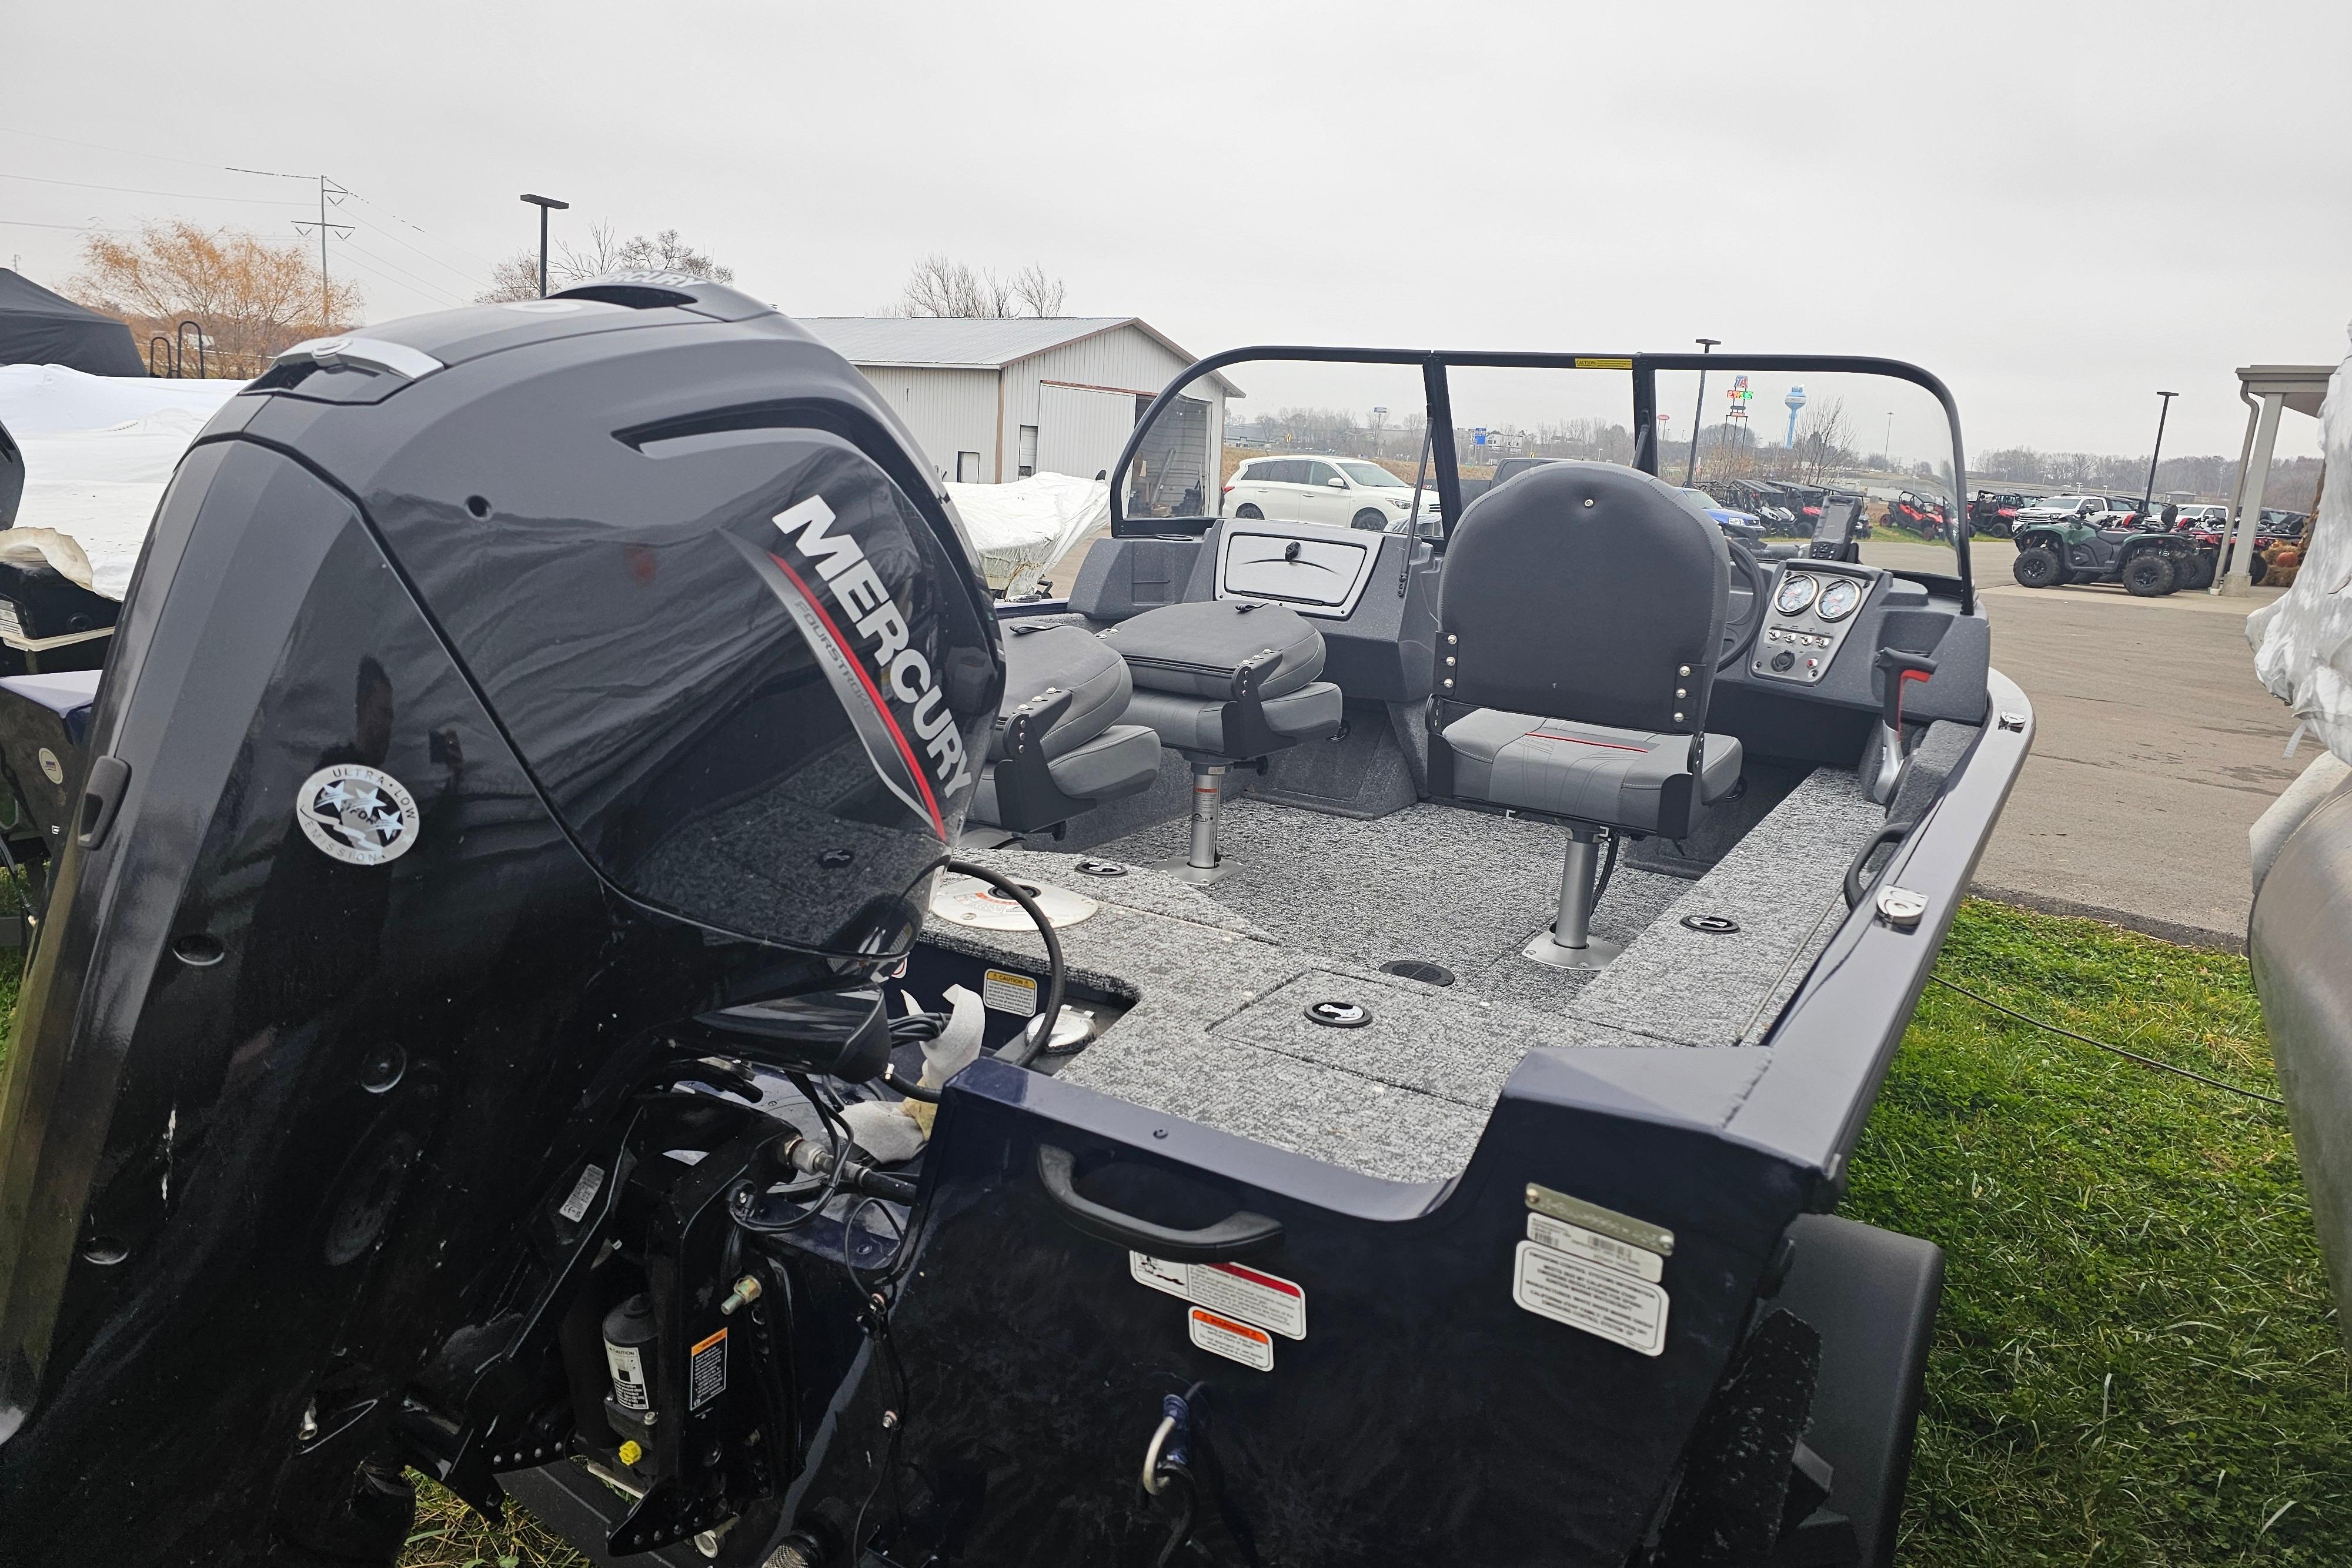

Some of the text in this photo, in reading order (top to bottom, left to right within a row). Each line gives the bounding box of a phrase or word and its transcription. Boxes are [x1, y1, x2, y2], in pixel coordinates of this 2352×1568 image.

[773, 494, 972, 798] MERCURY
[794, 599, 876, 714] FOURSTROKE
[333, 767, 384, 787] ULTRA
[395, 789, 416, 819] LOW
[999, 975, 1023, 984] CAUTION
